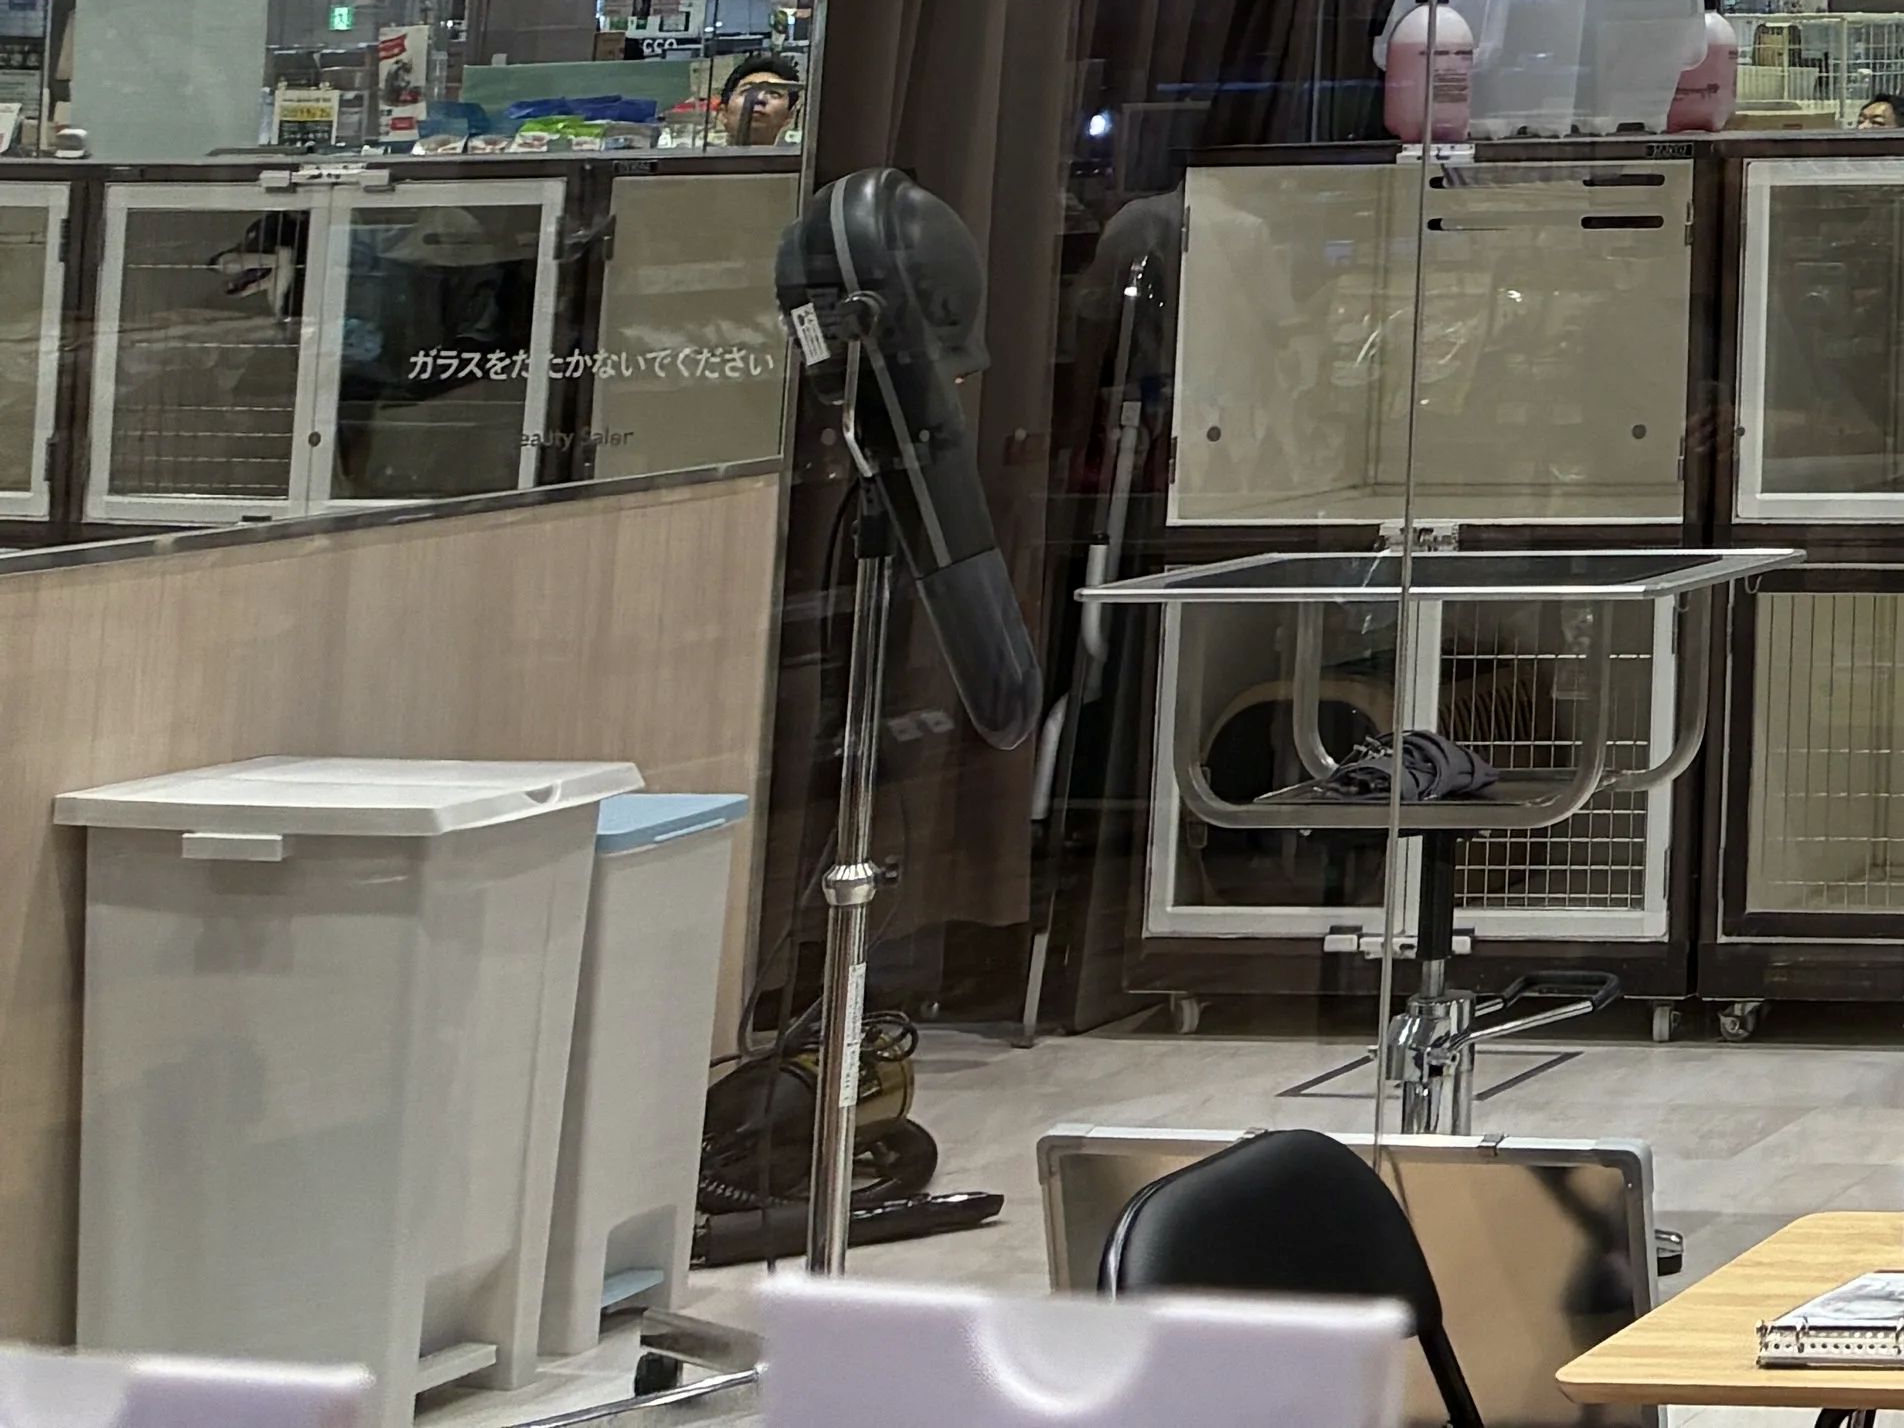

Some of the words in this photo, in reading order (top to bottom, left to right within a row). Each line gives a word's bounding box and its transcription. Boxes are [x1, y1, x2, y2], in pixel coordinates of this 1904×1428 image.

[408, 348, 775, 380] ガラスをたたかないでください
